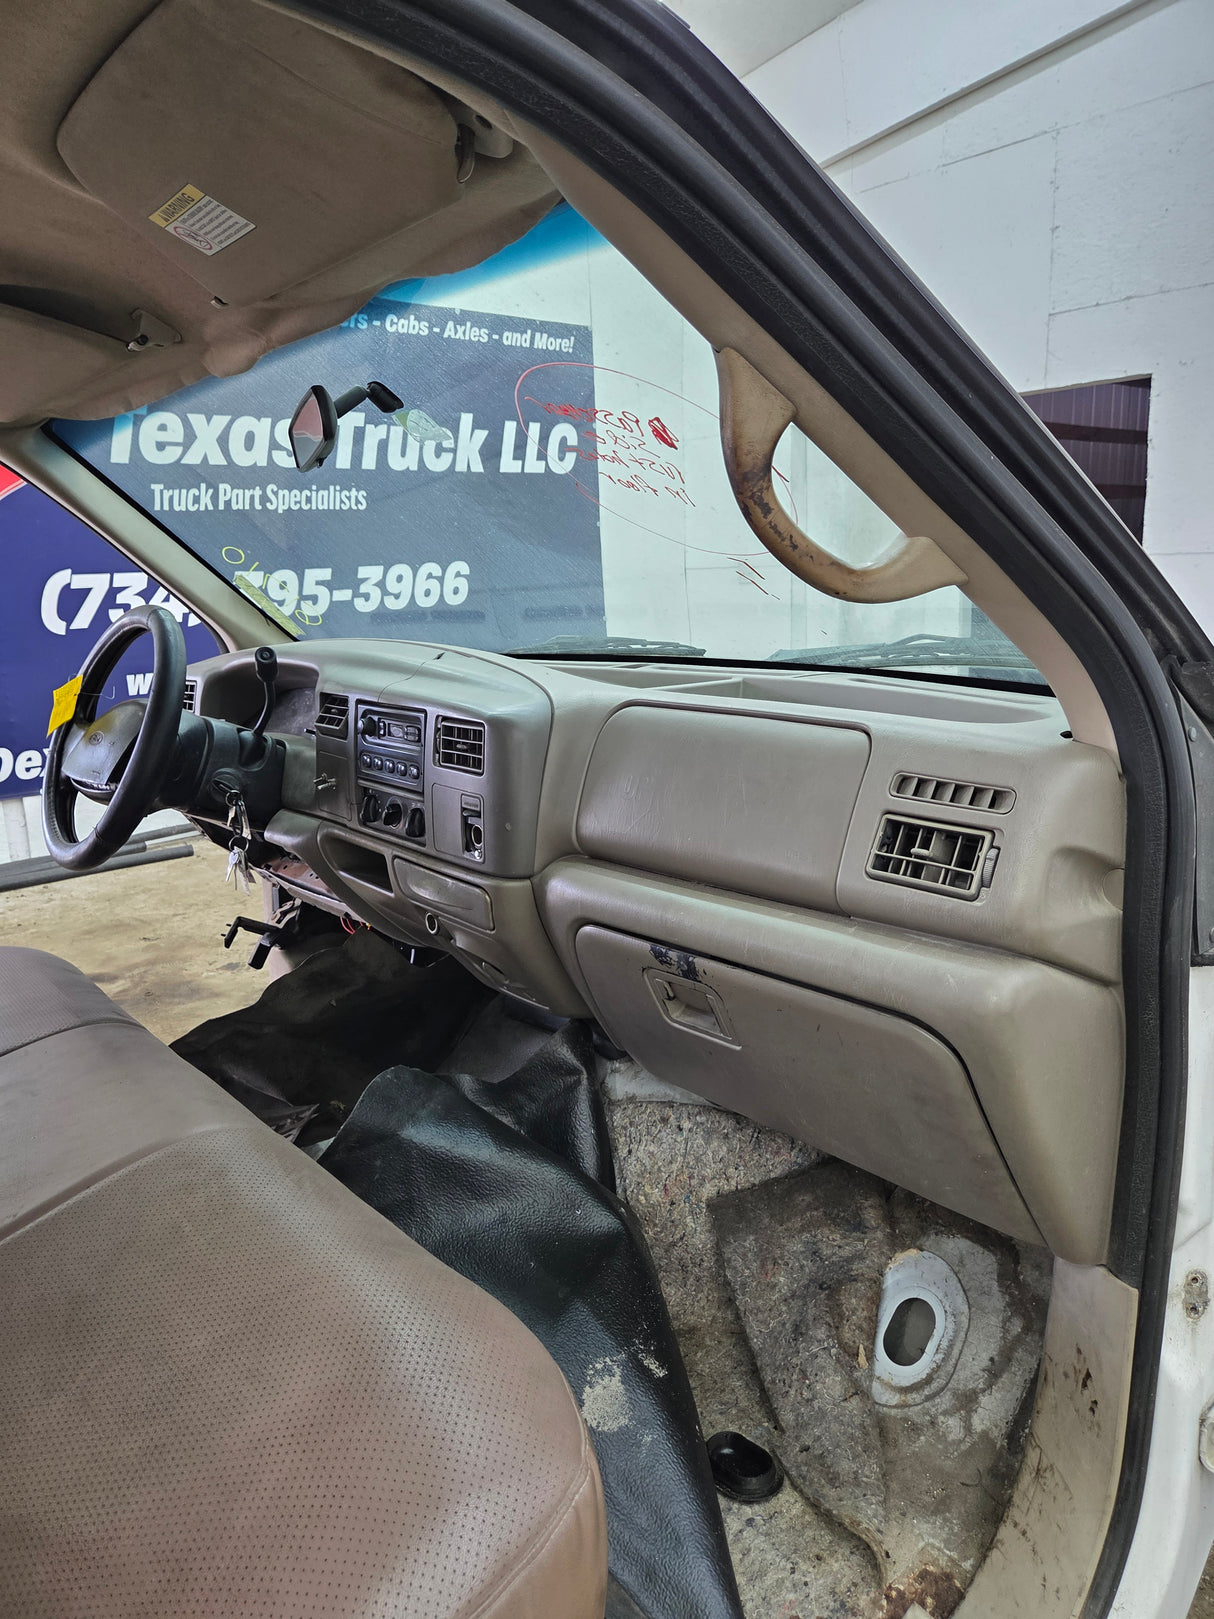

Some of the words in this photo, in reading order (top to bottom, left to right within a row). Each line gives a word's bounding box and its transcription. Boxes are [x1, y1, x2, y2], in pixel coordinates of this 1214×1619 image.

[160, 192, 195, 221] WARNING
[341, 313, 368, 330] rs
[385, 313, 429, 337] Cabs
[443, 320, 489, 344] Axles
[503, 330, 531, 349] and
[533, 334, 575, 353] More!
[335, 410, 489, 472] Truck
[499, 420, 579, 475] LLC
[151, 483, 214, 512] Truck
[218, 483, 263, 511] Part
[266, 483, 368, 513] Specialists
